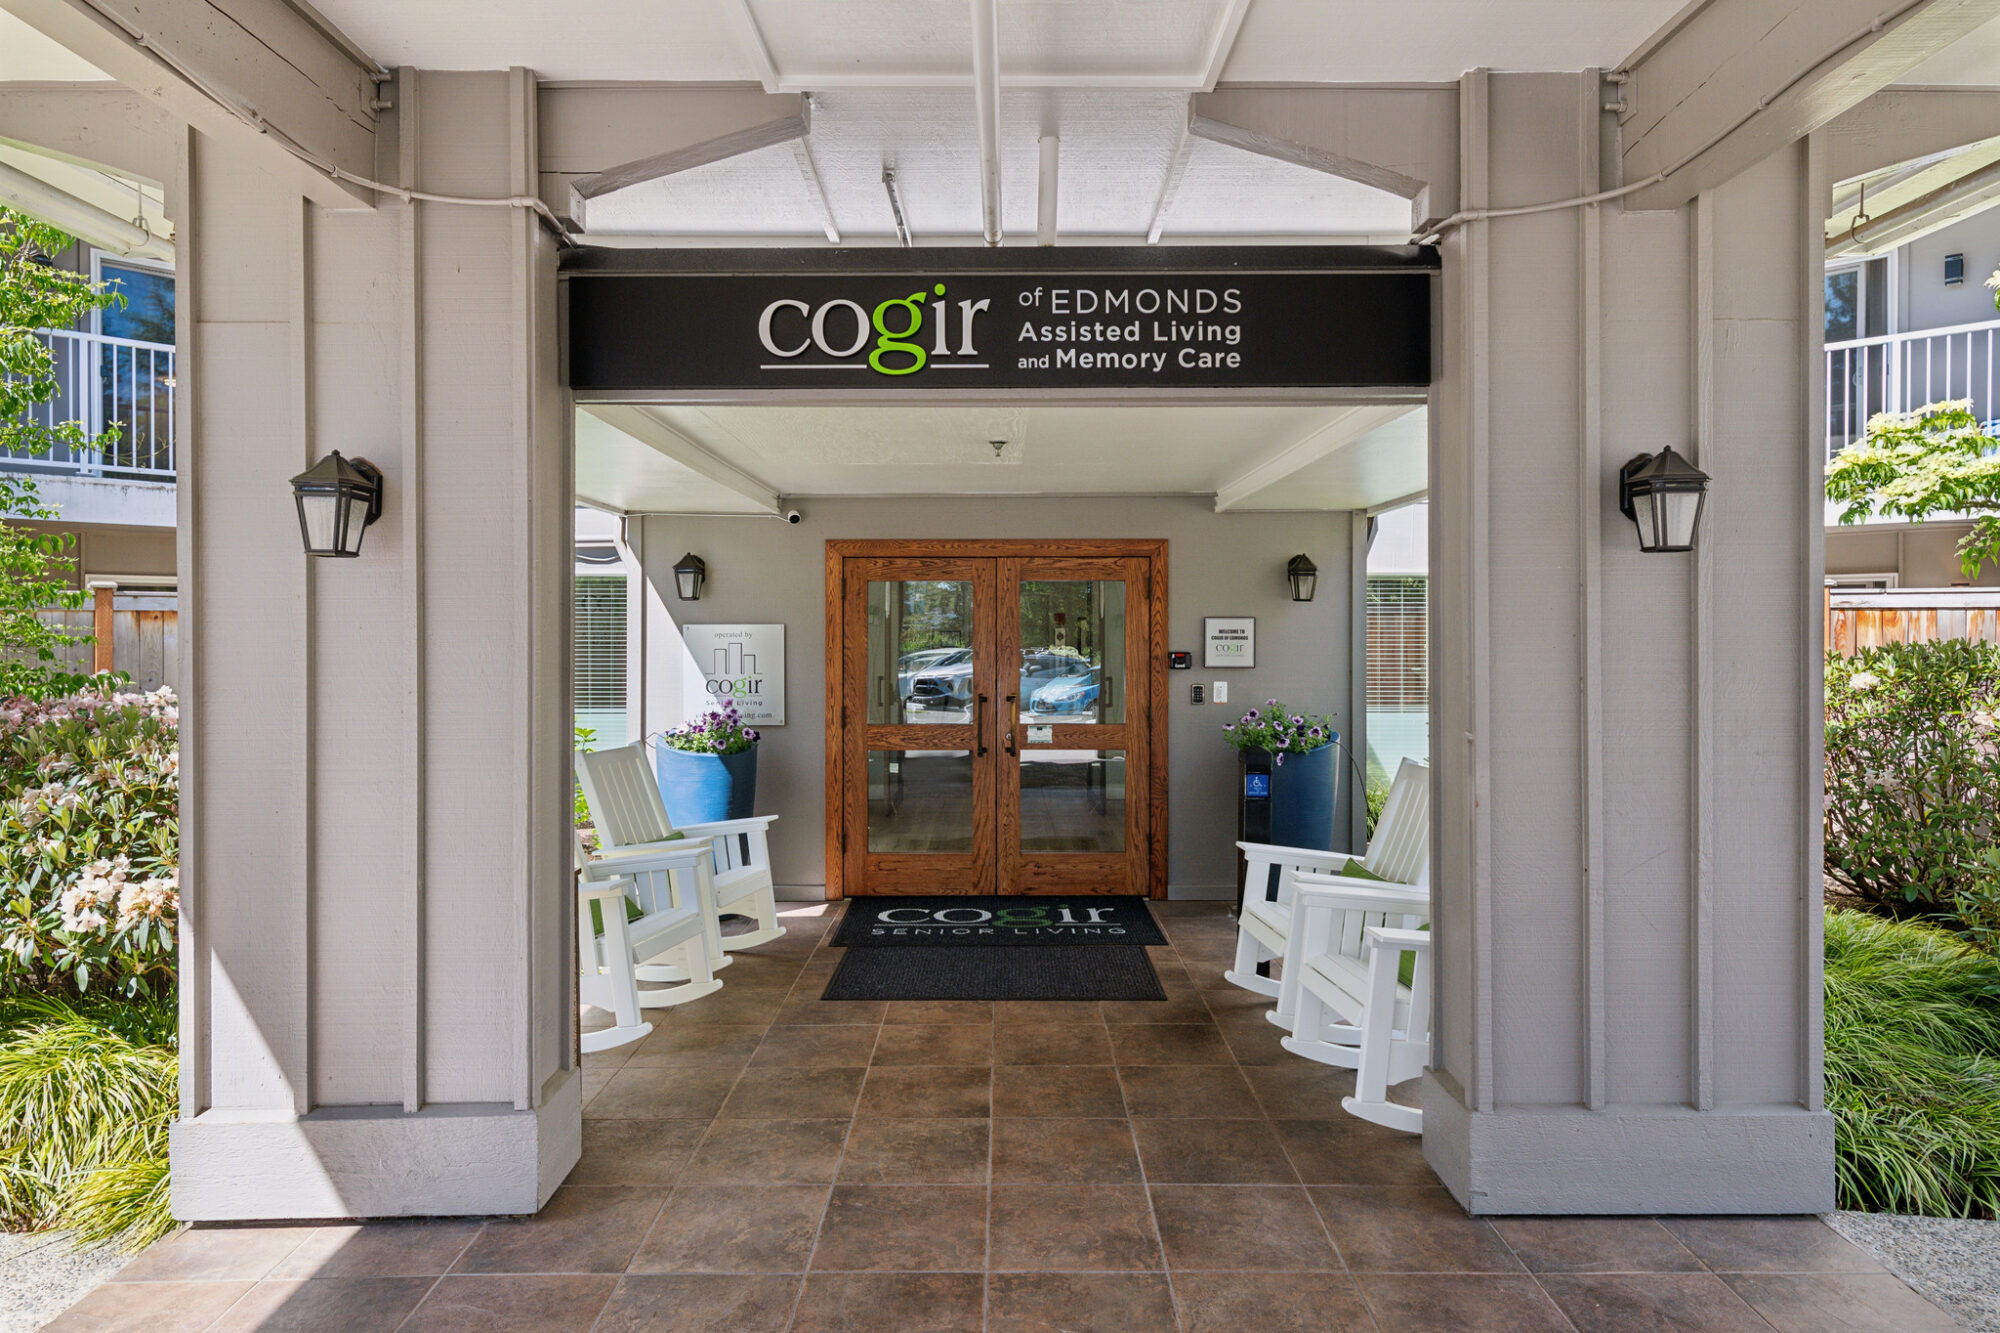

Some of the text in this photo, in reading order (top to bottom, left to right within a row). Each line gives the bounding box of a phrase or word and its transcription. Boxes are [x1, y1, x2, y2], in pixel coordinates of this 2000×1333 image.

[1018, 287, 1242, 314] of EDMONDS
[758, 283, 991, 376] cogir
[1018, 320, 1241, 345] Assisted Living
[1017, 347, 1241, 373] and Memory Care
[714, 631, 752, 639] operated by
[1216, 643, 1244, 653] cogir
[705, 675, 763, 698] cogir
[876, 904, 1115, 928] cogir
[871, 927, 1126, 935] SENIOR LIVING
